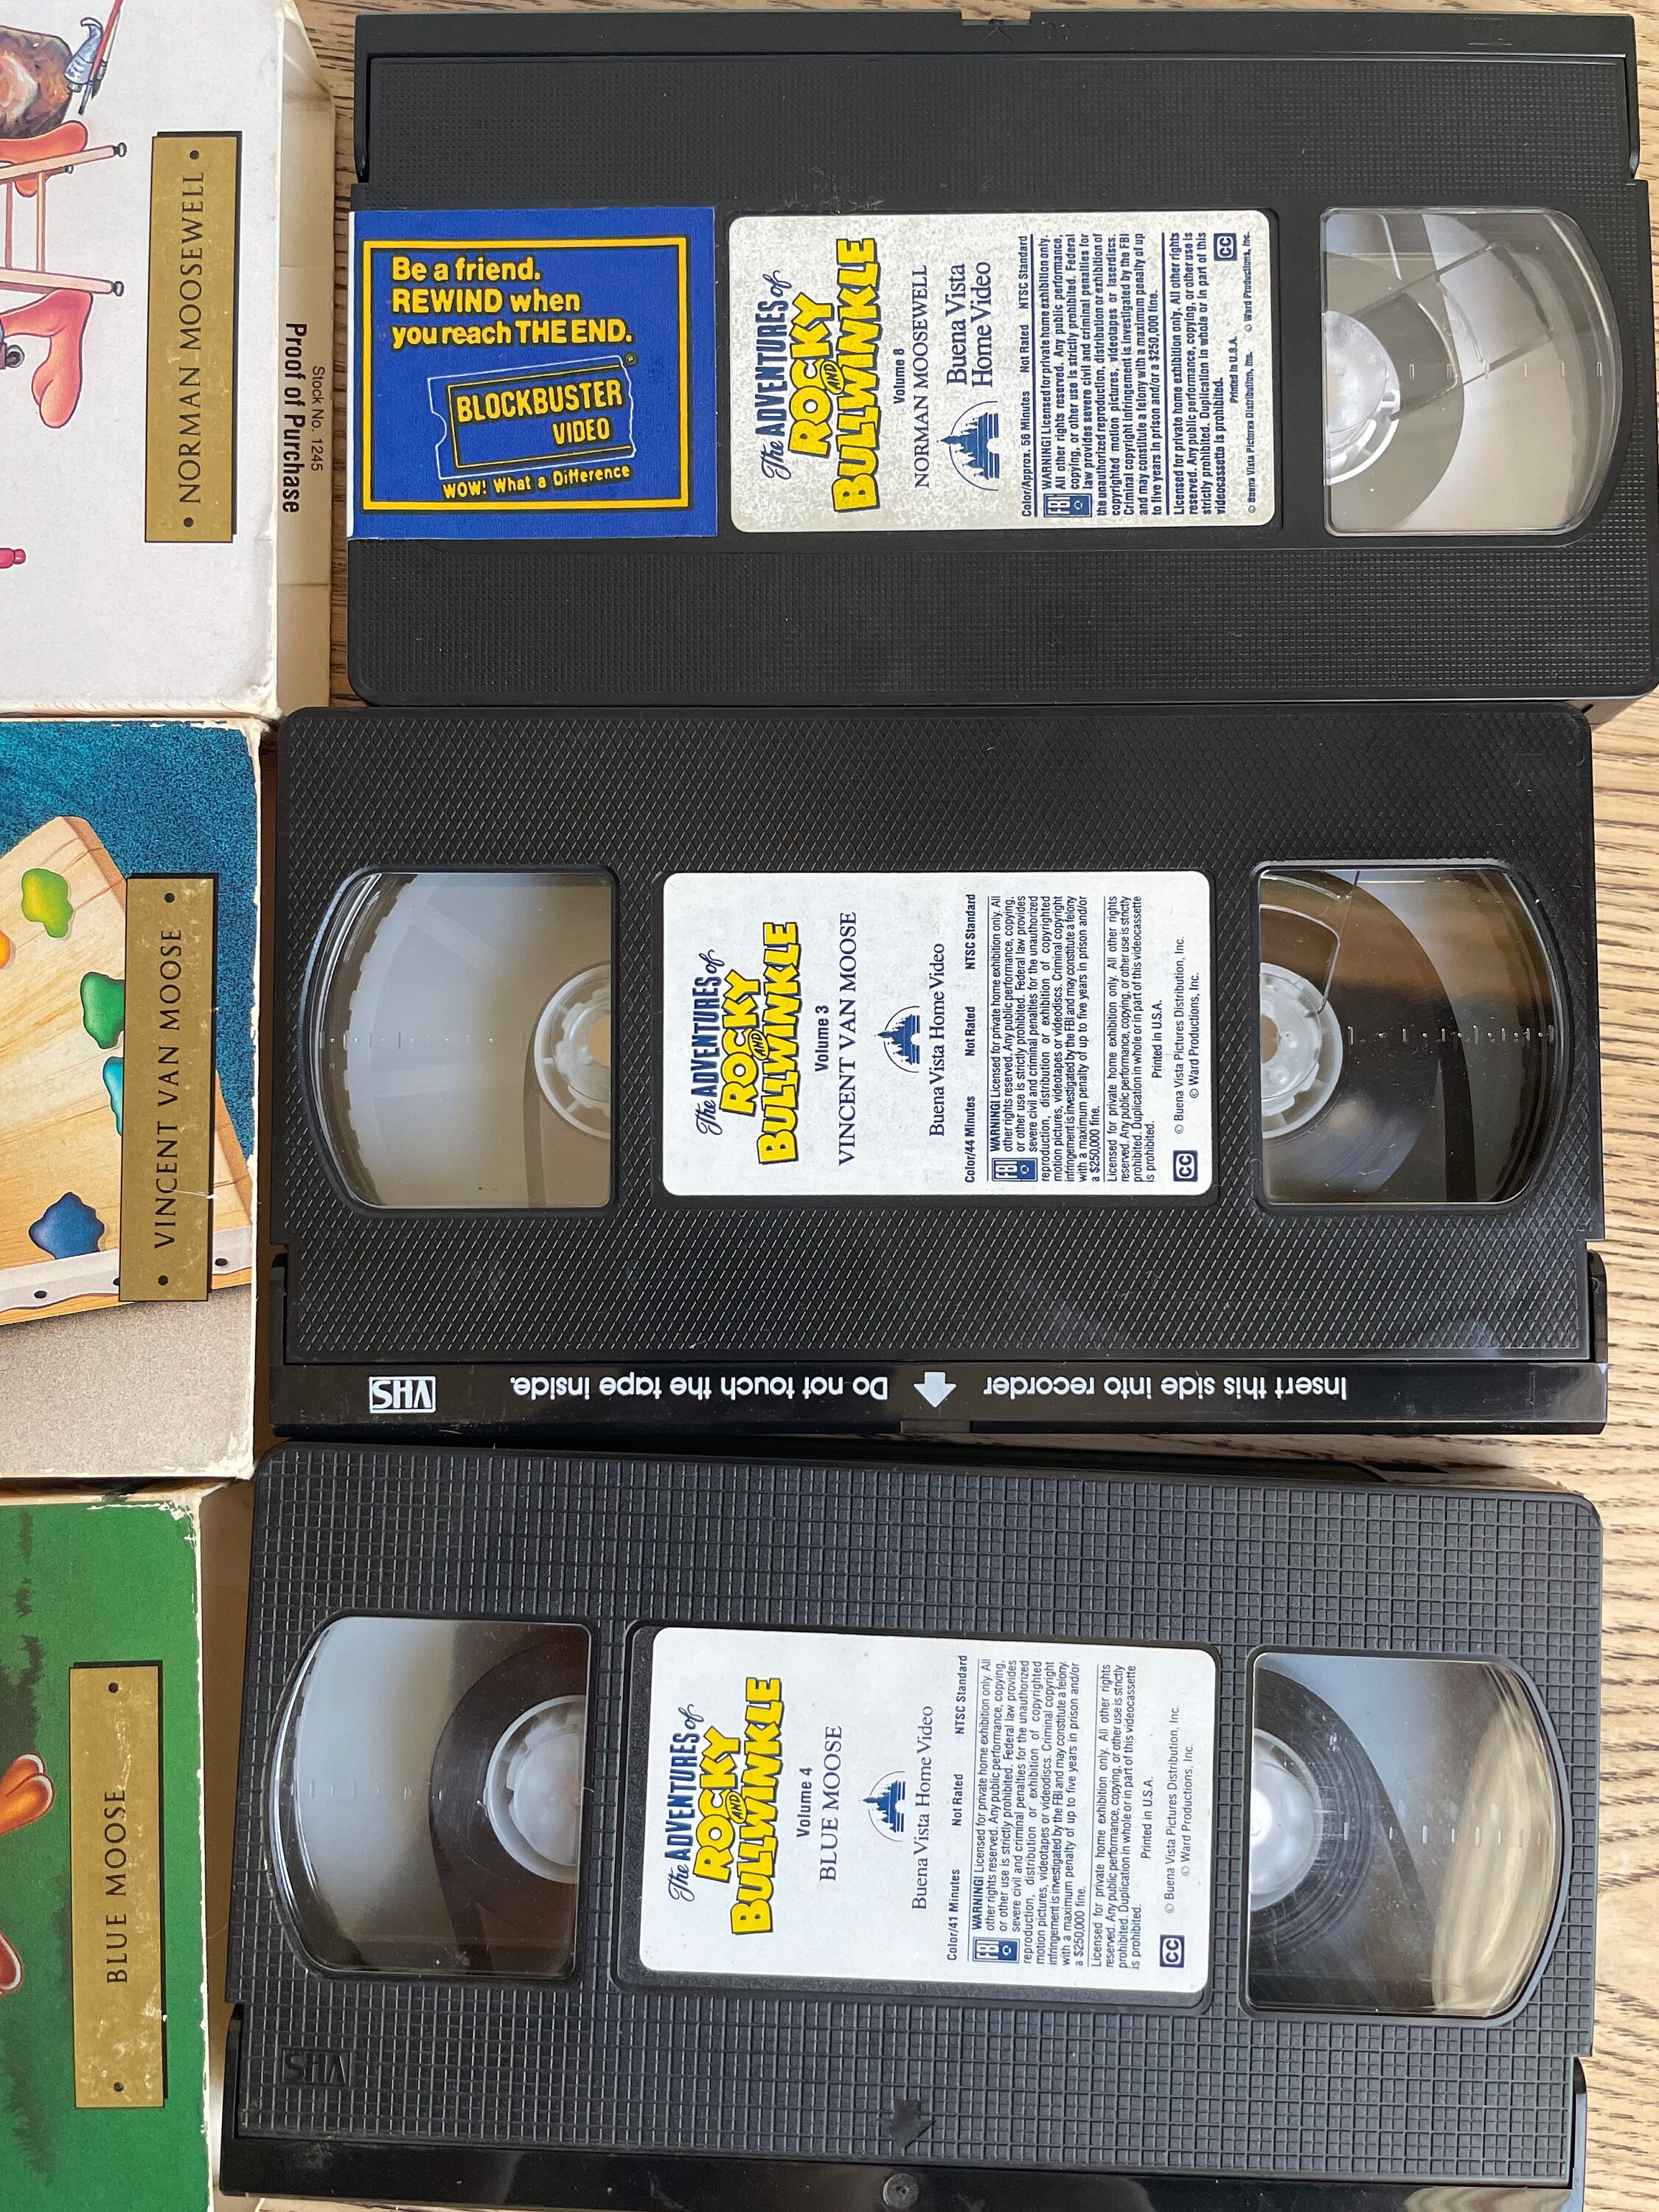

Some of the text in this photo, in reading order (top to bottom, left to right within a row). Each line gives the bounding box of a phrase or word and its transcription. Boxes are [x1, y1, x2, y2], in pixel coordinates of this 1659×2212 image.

[392, 256, 541, 281] Be a friend.
[1018, 235, 1029, 309] NTSC Standard
[1219, 236, 1232, 257] CC
[392, 288, 580, 313] REWIND when
[945, 264, 967, 385] Buena Vista
[970, 262, 992, 388] Home Video
[1147, 290, 1158, 312] fine.
[178, 172, 205, 504] NORMAN MOOSEWELL
[392, 320, 633, 349] you reach THE END.
[1019, 324, 1029, 372] Not Rated
[1147, 315, 1161, 361] $250,000
[456, 380, 623, 422] BLOCKBUSTER
[755, 271, 792, 480] The ADVENTURES of
[788, 292, 834, 459] ROCKY
[823, 363, 842, 392] AND
[832, 238, 882, 512] BULLWINKLE
[893, 359, 905, 404] Volume
[912, 265, 929, 487] NORMAN MOOSEWELL
[1149, 372, 1161, 405] and/or
[282, 323, 307, 514] Proof of Purchase
[310, 366, 324, 472] Stock No. 1245
[552, 417, 611, 445] VIDEO
[1150, 407, 1162, 438] prison
[1020, 390, 1032, 516] Color/Approx. 56 Minutes
[1150, 441, 1161, 451] in
[1152, 453, 1163, 481] years
[442, 464, 630, 500] WOW! What a Difference
[1047, 495, 1071, 515] FBI
[1151, 484, 1161, 502] five
[1152, 505, 1162, 515] to
[965, 893, 975, 969] NTSC Standard
[691, 950, 724, 1135] The ADVENTURES of
[719, 969, 759, 1116] ROCKY
[750, 1033, 767, 1057] AND
[757, 922, 802, 1164] BULLWINKLE
[815, 1006, 829, 1071] Volume 3
[838, 912, 856, 1165] VINCENT VAN MOOSE
[929, 944, 945, 1135] Buena Vista Home Video
[965, 1006, 975, 1056] Not Rated
[990, 896, 1003, 1151] WARNING! Licensed for private home exhibition only. All
[1040, 896, 1052, 1181] reproduction, distribution or exhibition of copyrighted
[1152, 1000, 1162, 1077] Printed in U.S.A.
[153, 928, 182, 1250] VINCENT VAN MOOSE
[1090, 1105, 1099, 1126] fine.
[965, 1096, 975, 1182] Color/44 Minutes
[1089, 1129, 1101, 1172] $250,000
[995, 1161, 1018, 1178] FBI
[1178, 1155, 1192, 1177] CC
[371, 1378, 434, 1411] VHS
[510, 1372, 888, 1399] Do not touch the tape inside.
[984, 1374, 1347, 1400] Insert this side into recorder
[955, 1655, 967, 1734] NTSC Standard
[664, 1704, 704, 1902] The ADVENTURES of
[692, 1726, 740, 1883] ROCKY
[727, 1794, 743, 1820] AND
[730, 1677, 785, 1935] BULLWINKLE
[796, 1767, 813, 1837] Volume 4
[819, 1725, 842, 1881] BLUE MOOSE
[912, 1706, 933, 1909] Buena Vista Home Video
[952, 1773, 964, 1826] Not Rated
[1022, 1660, 1043, 1964] reproduction, distribution or exhibition of copyrighted
[1141, 1776, 1153, 1858] Printed in U.S.A.
[104, 1790, 128, 1984] BLUE MOOSE
[1075, 1885, 1085, 1907] fine.
[947, 1868, 960, 1961] Color/41 Minutes
[1073, 1910, 1086, 1956] $250,000
[976, 1940, 999, 1959] FBI
[1165, 1938, 1180, 1963] CC
[285, 2051, 347, 2087] VHS
